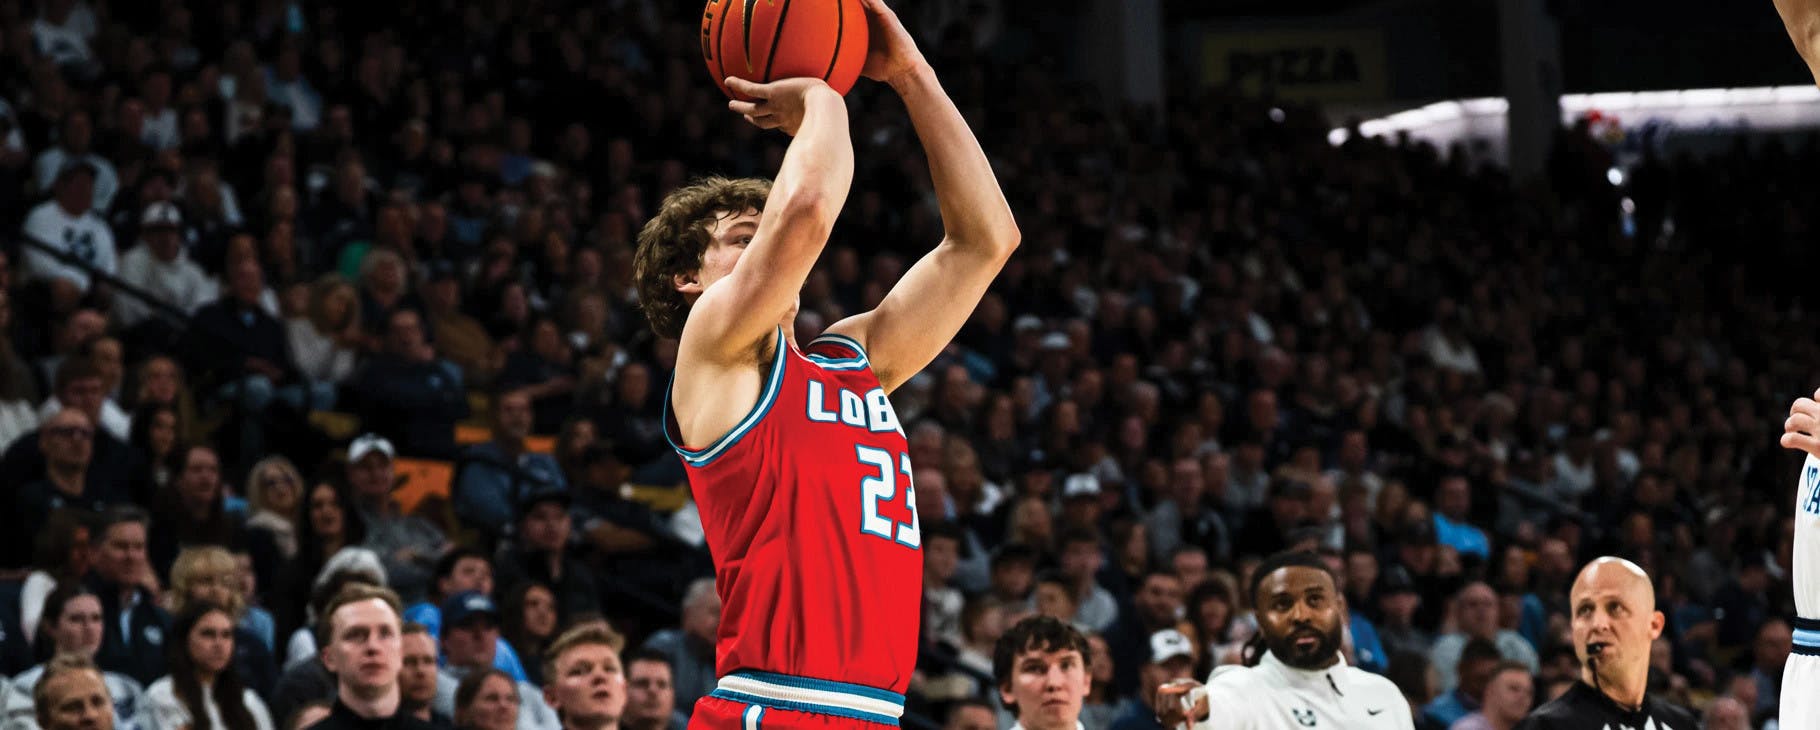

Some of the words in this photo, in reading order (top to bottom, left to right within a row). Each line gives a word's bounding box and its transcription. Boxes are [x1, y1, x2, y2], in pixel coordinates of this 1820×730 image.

[1229, 48, 1360, 87] PIZZA
[806, 379, 907, 439] LOB
[855, 443, 921, 549] 23
